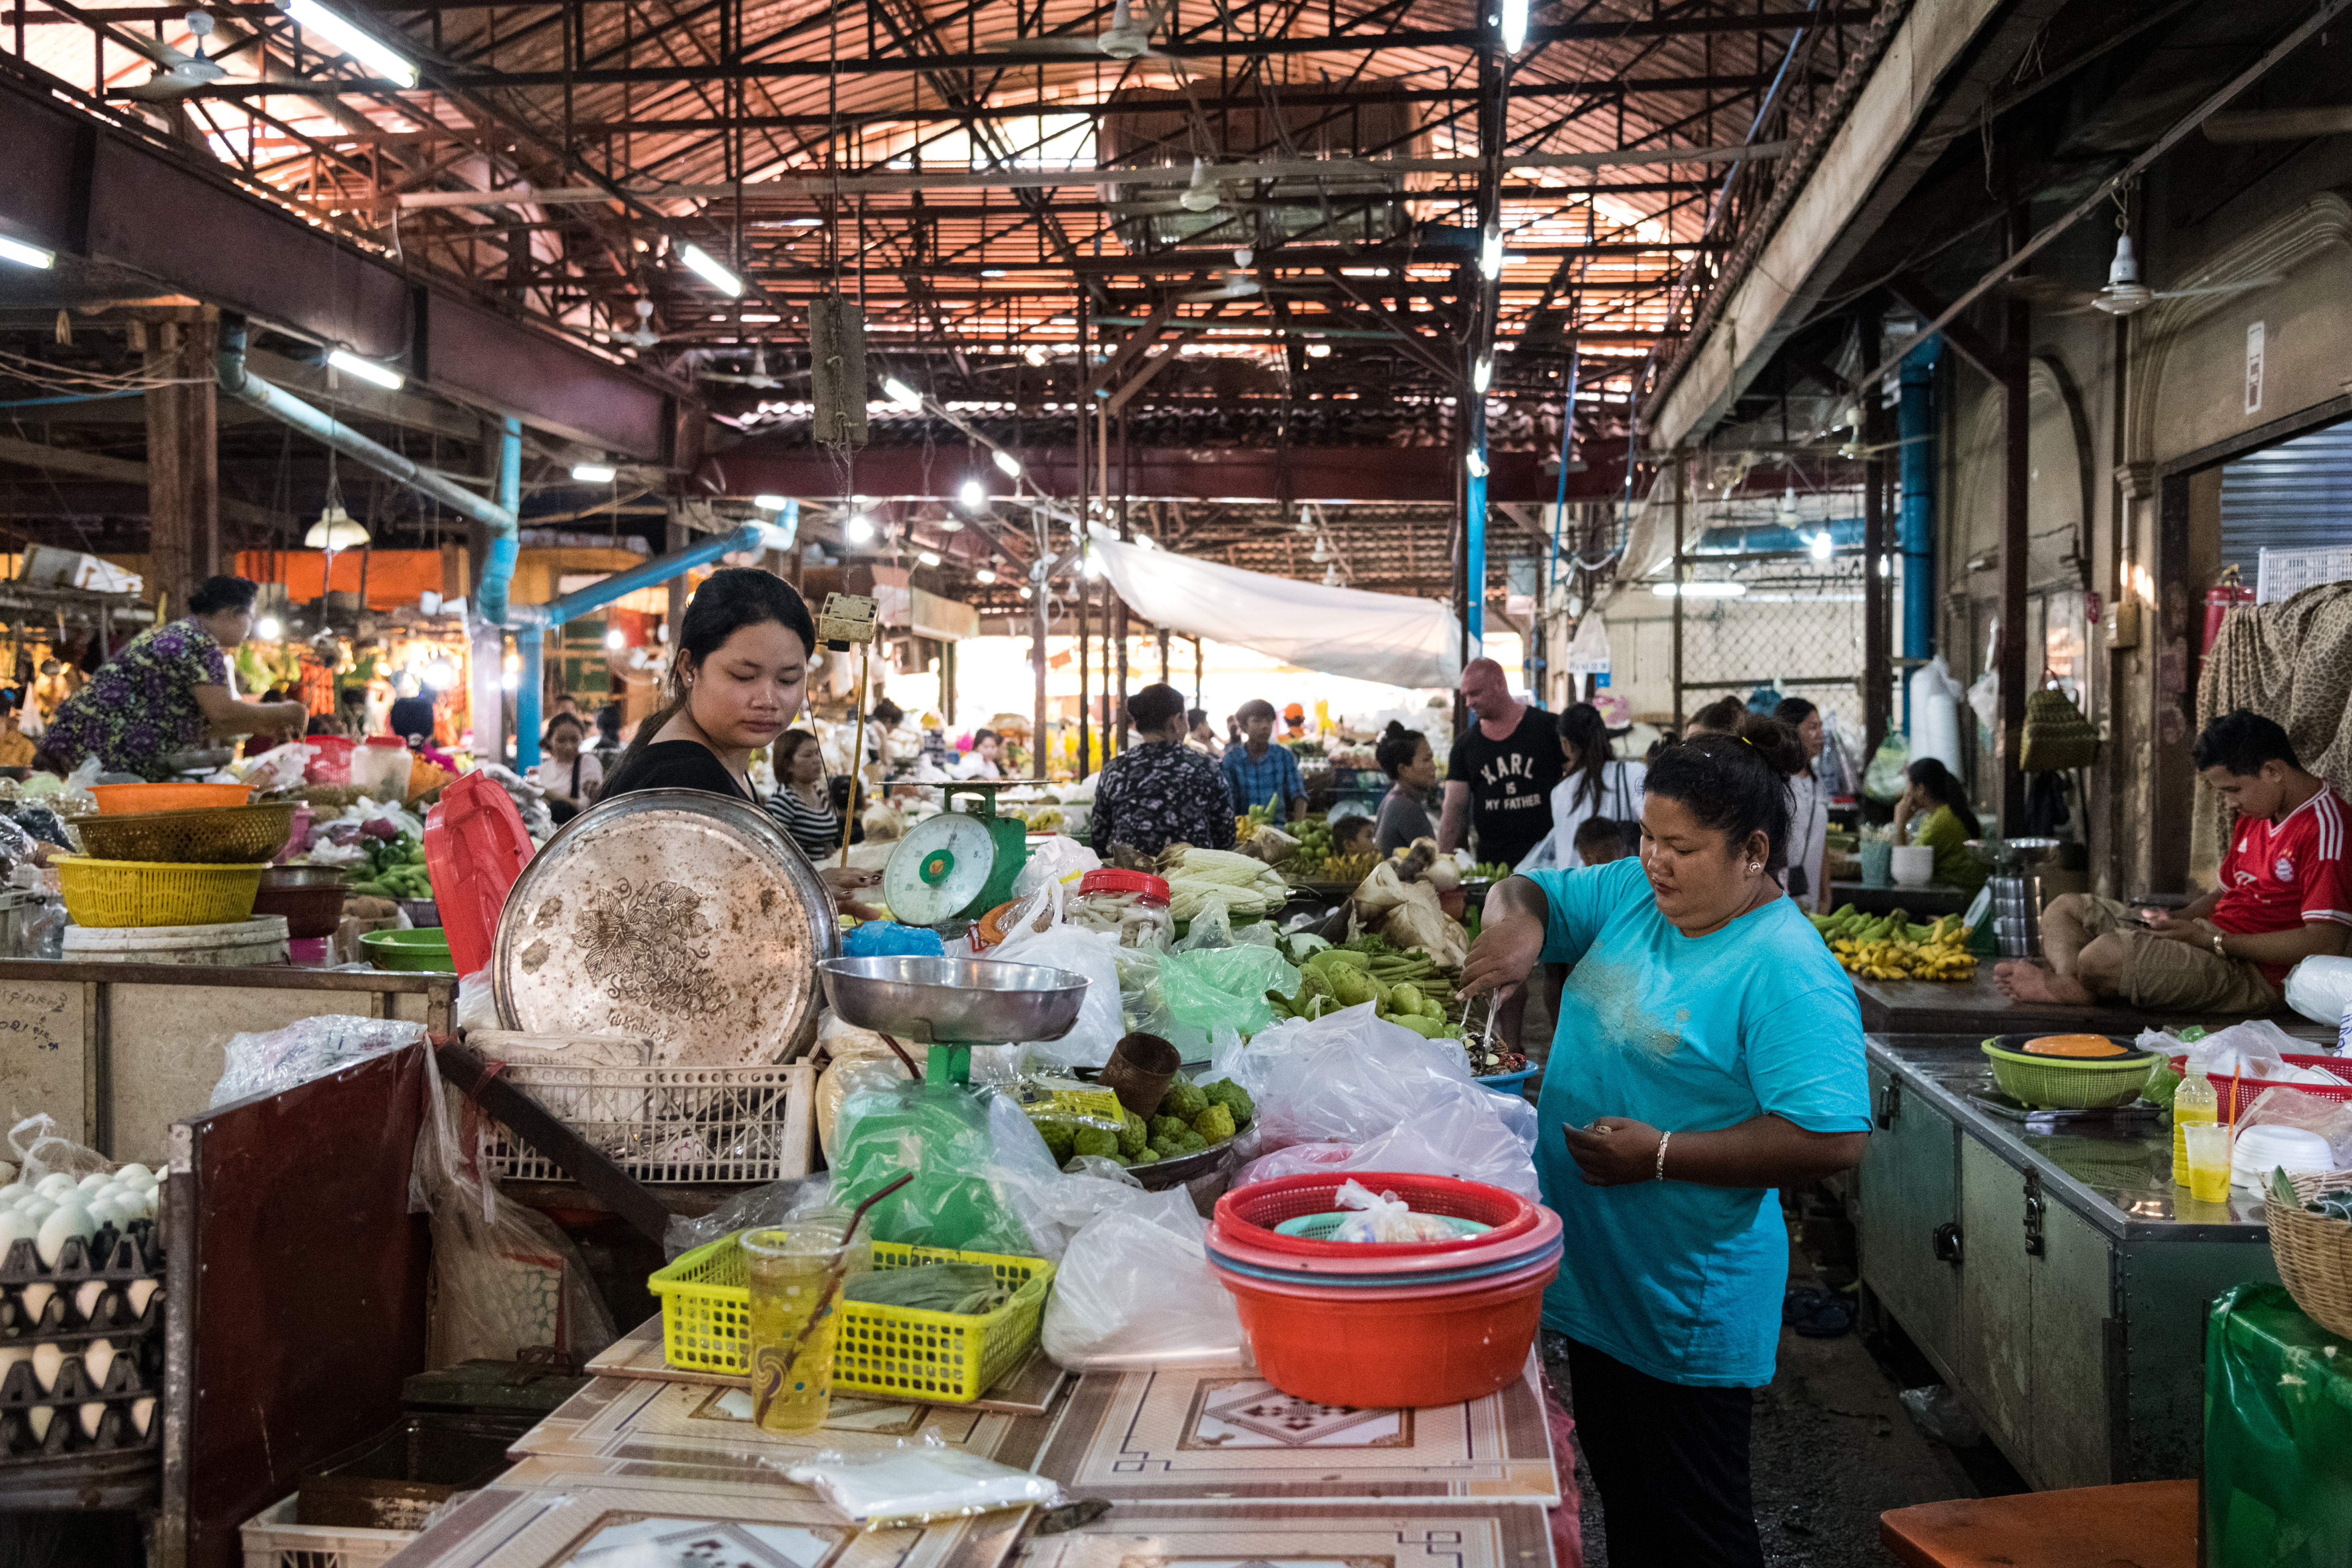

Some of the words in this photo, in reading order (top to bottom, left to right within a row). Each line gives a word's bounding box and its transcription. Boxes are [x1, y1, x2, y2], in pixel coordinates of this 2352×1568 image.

[1480, 752, 1534, 786] KARL
[1505, 781, 1516, 795] IS
[1485, 799, 1500, 810] MY
[1503, 793, 1541, 810] FATHER
